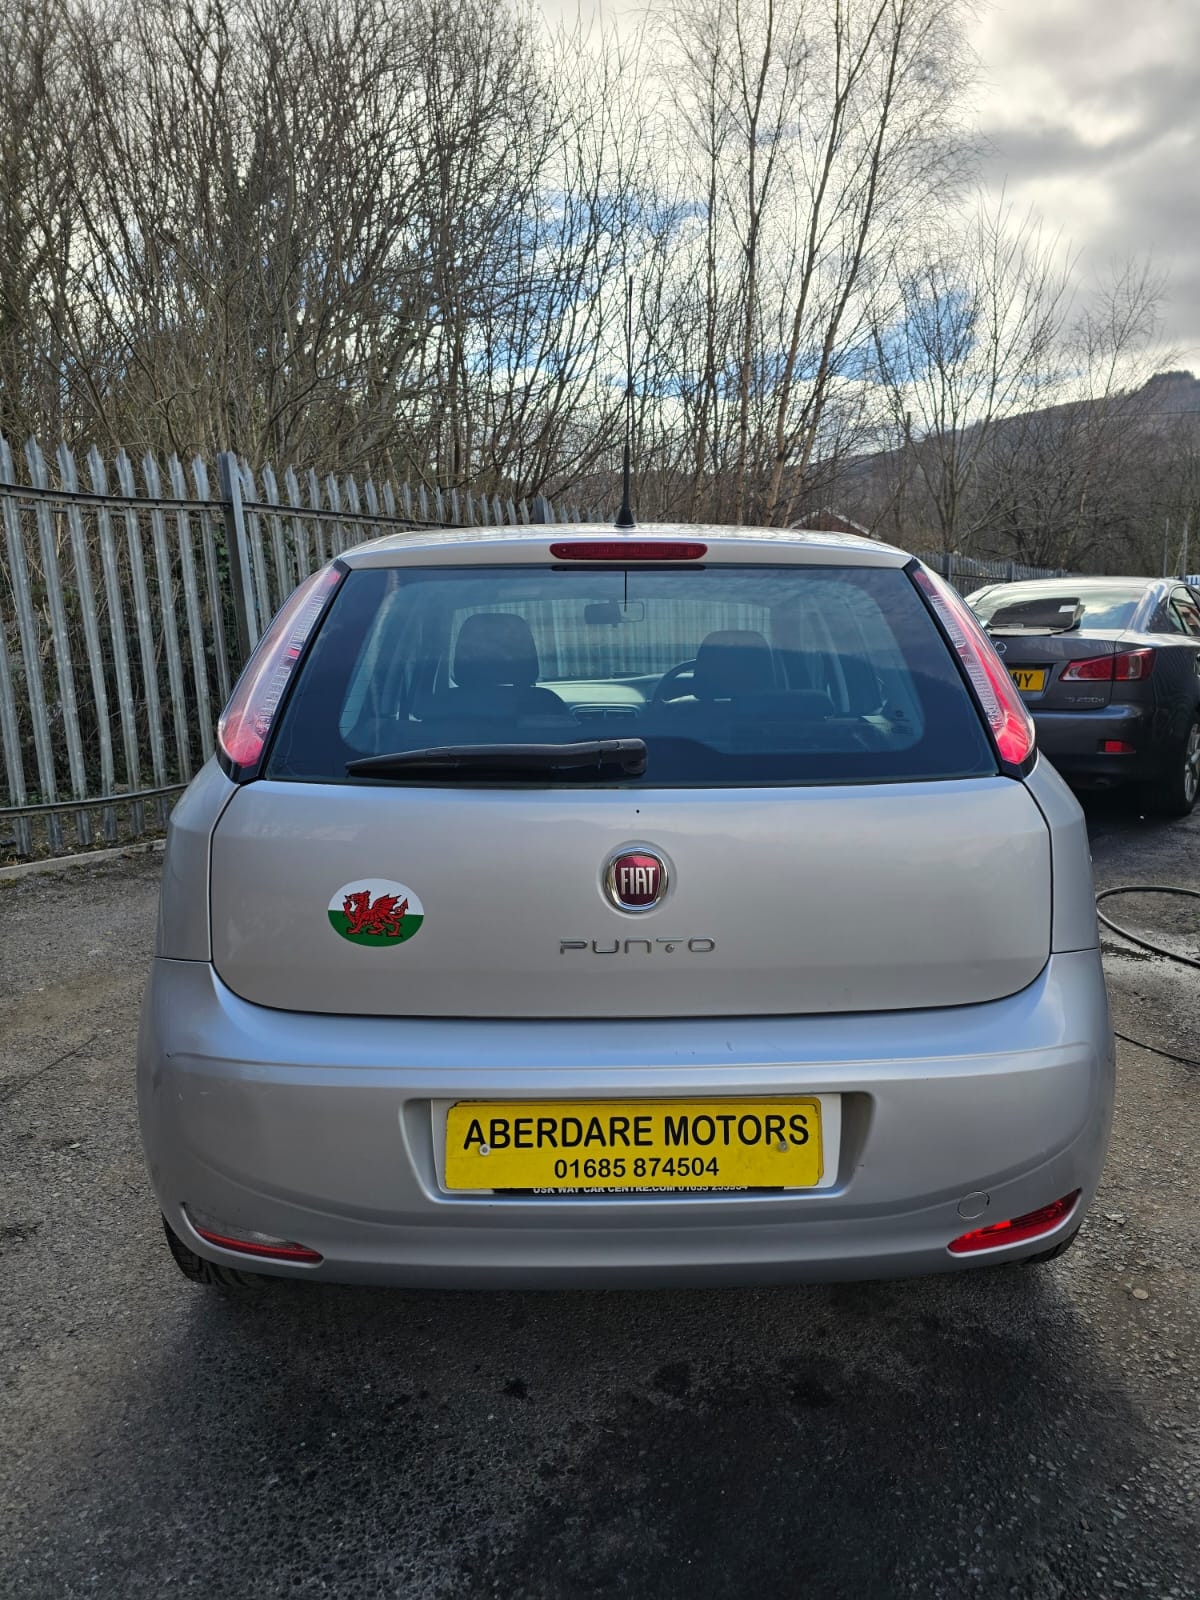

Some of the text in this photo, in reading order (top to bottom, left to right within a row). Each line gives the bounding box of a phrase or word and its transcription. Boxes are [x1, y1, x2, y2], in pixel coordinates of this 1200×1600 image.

[620, 866, 656, 895] FIAT
[559, 937, 716, 955] PUNTO
[463, 1114, 810, 1151] ABERDARE MOTORS
[554, 1156, 720, 1179] 01685 874504
